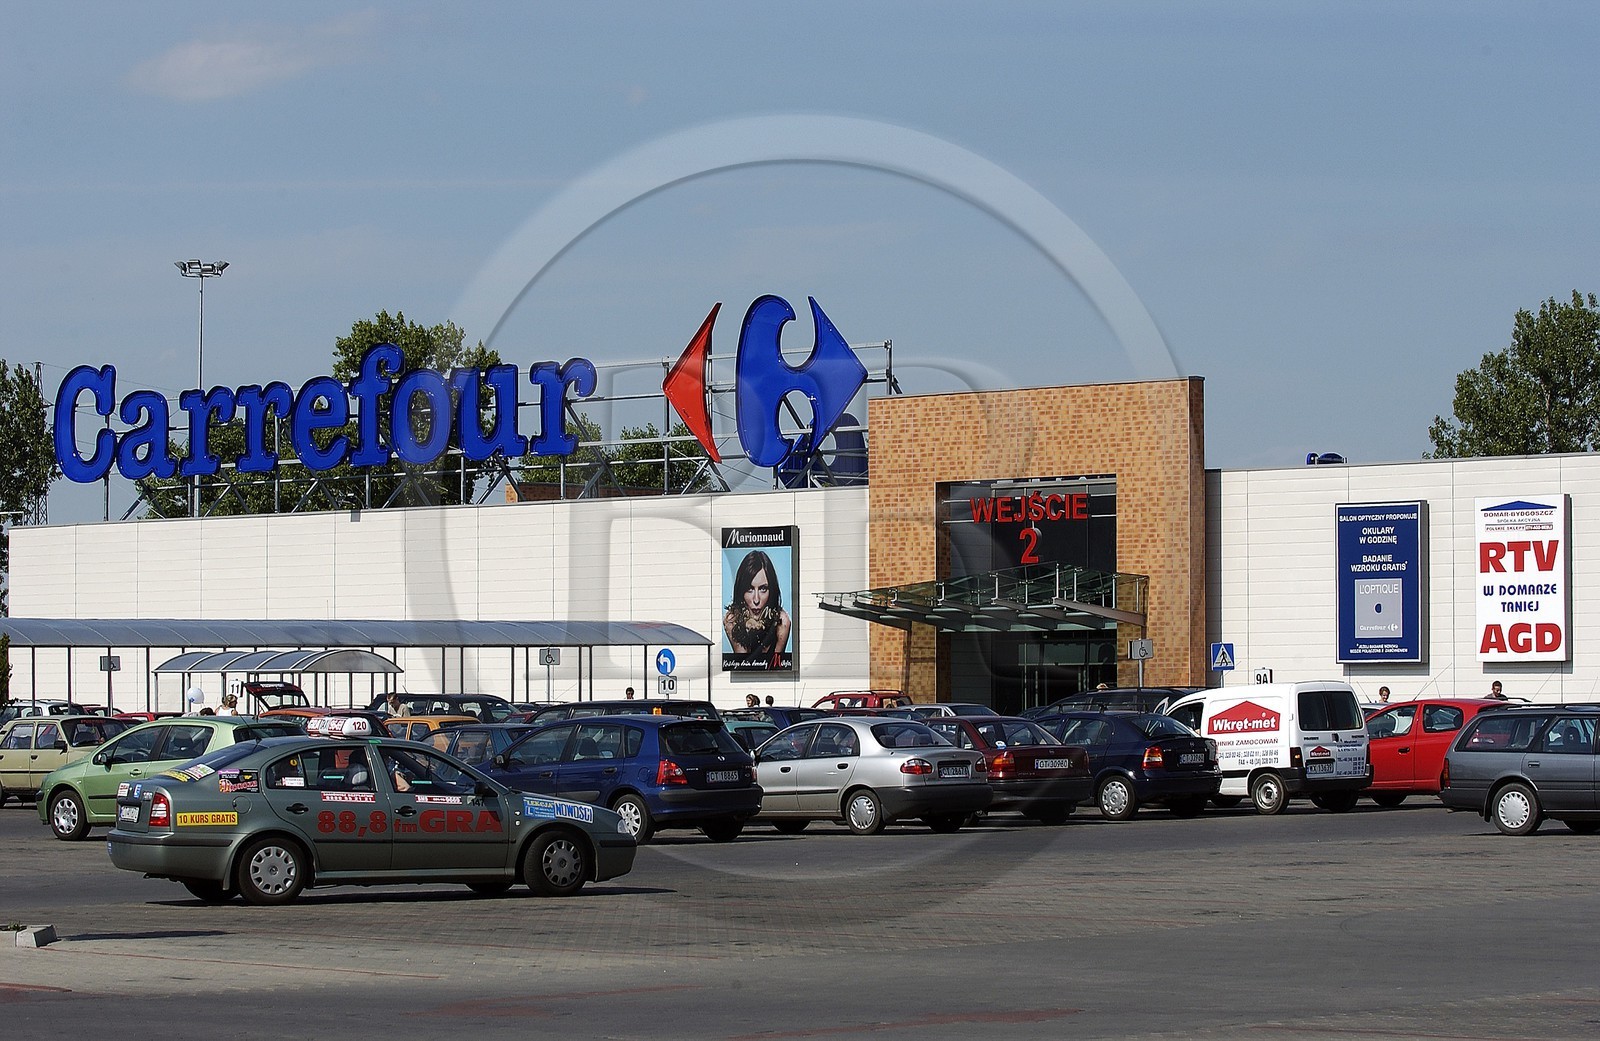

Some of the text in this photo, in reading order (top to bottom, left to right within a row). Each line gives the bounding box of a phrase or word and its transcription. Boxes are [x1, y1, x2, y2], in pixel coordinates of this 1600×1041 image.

[53, 343, 598, 484] Carrefour
[970, 490, 1088, 524] WEJŚCIE
[1385, 512, 1417, 520] PROPONUJE
[1483, 510, 1554, 518] DOMAR-BYDGOSZCZ
[1361, 526, 1395, 535] OKULARY
[725, 528, 784, 548] Marionnaud
[1367, 535, 1398, 545] GODZINĘ
[1019, 527, 1039, 564] 2
[1362, 554, 1393, 563] BADANIE
[1479, 540, 1560, 573] RTV
[1350, 563, 1381, 572] WZROKU
[1359, 583, 1399, 595] L'OPTIQUE
[1483, 583, 1557, 597] W DOMARZE
[1501, 600, 1539, 613] TANIEJ
[1479, 622, 1562, 654] AGD
[661, 679, 675, 691] 10
[1255, 673, 1268, 685] 9A
[230, 683, 240, 695] 11
[353, 721, 367, 731] 120
[1212, 716, 1276, 732] Wkręt-met
[1235, 738, 1279, 746] ZAMOCOWAŃ
[555, 801, 594, 823] NOWOŚCI
[178, 813, 236, 824] 10 KURS GRATIS
[317, 809, 503, 838] 88,8 fm GRA
